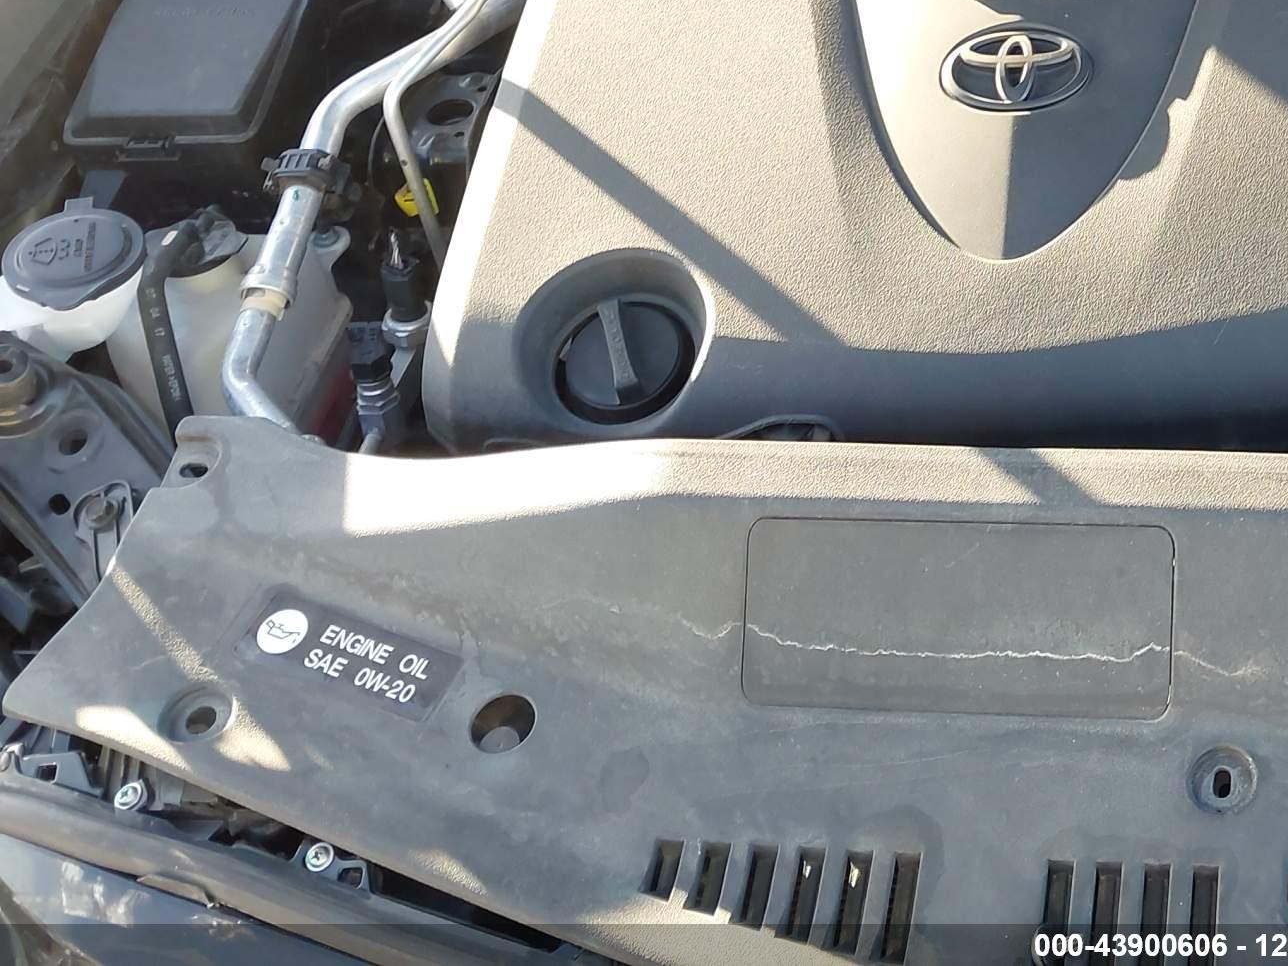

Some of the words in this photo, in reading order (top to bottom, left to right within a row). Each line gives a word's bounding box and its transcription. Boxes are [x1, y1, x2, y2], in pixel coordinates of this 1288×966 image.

[304, 649, 348, 678] SAE
[353, 667, 417, 703] 0W-20
[319, 624, 394, 665] ENGINE
[398, 653, 432, 680] OIL
